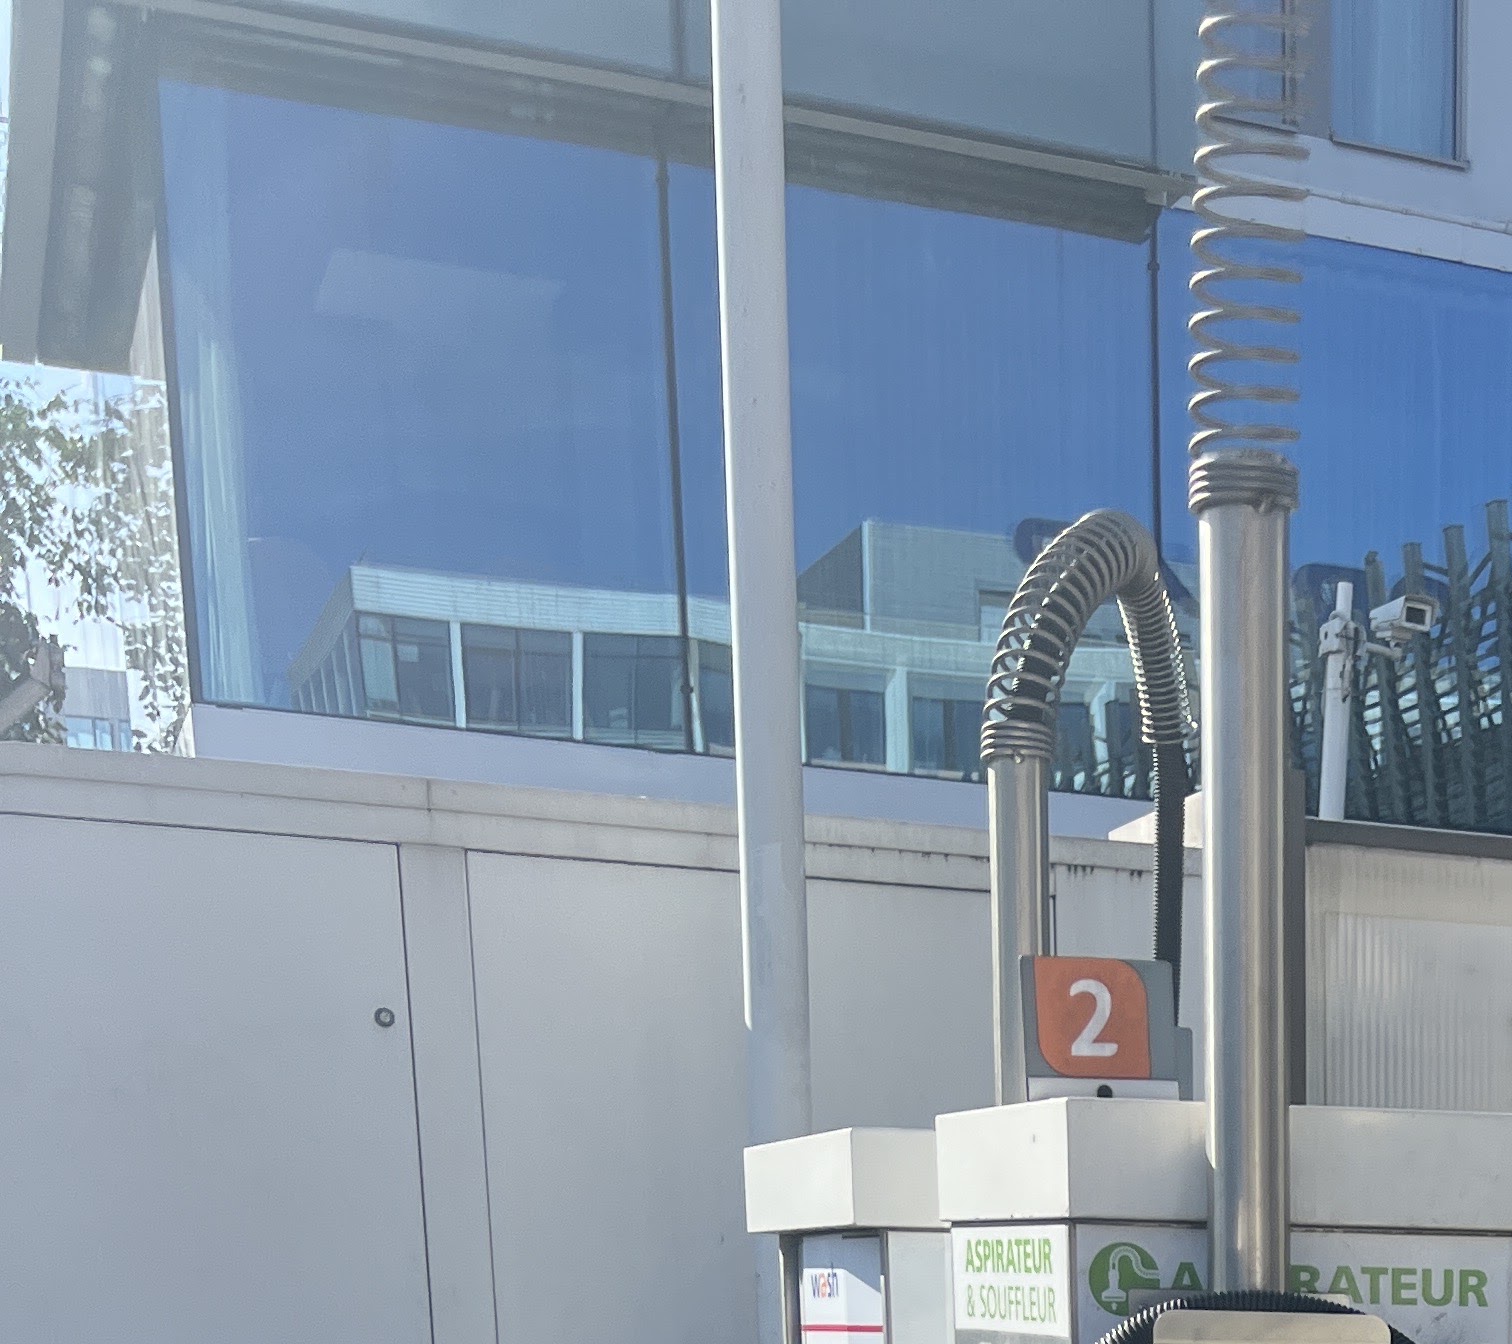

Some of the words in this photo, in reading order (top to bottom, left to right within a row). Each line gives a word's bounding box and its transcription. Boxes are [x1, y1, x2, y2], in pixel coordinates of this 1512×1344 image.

[1067, 977, 1119, 1058] 2
[965, 1238, 1053, 1274] ASPIRATEUR
[966, 1284, 975, 1318] &
[979, 1284, 1057, 1324] SOUFFLEUR
[1170, 1262, 1489, 1308] ARATEUR
